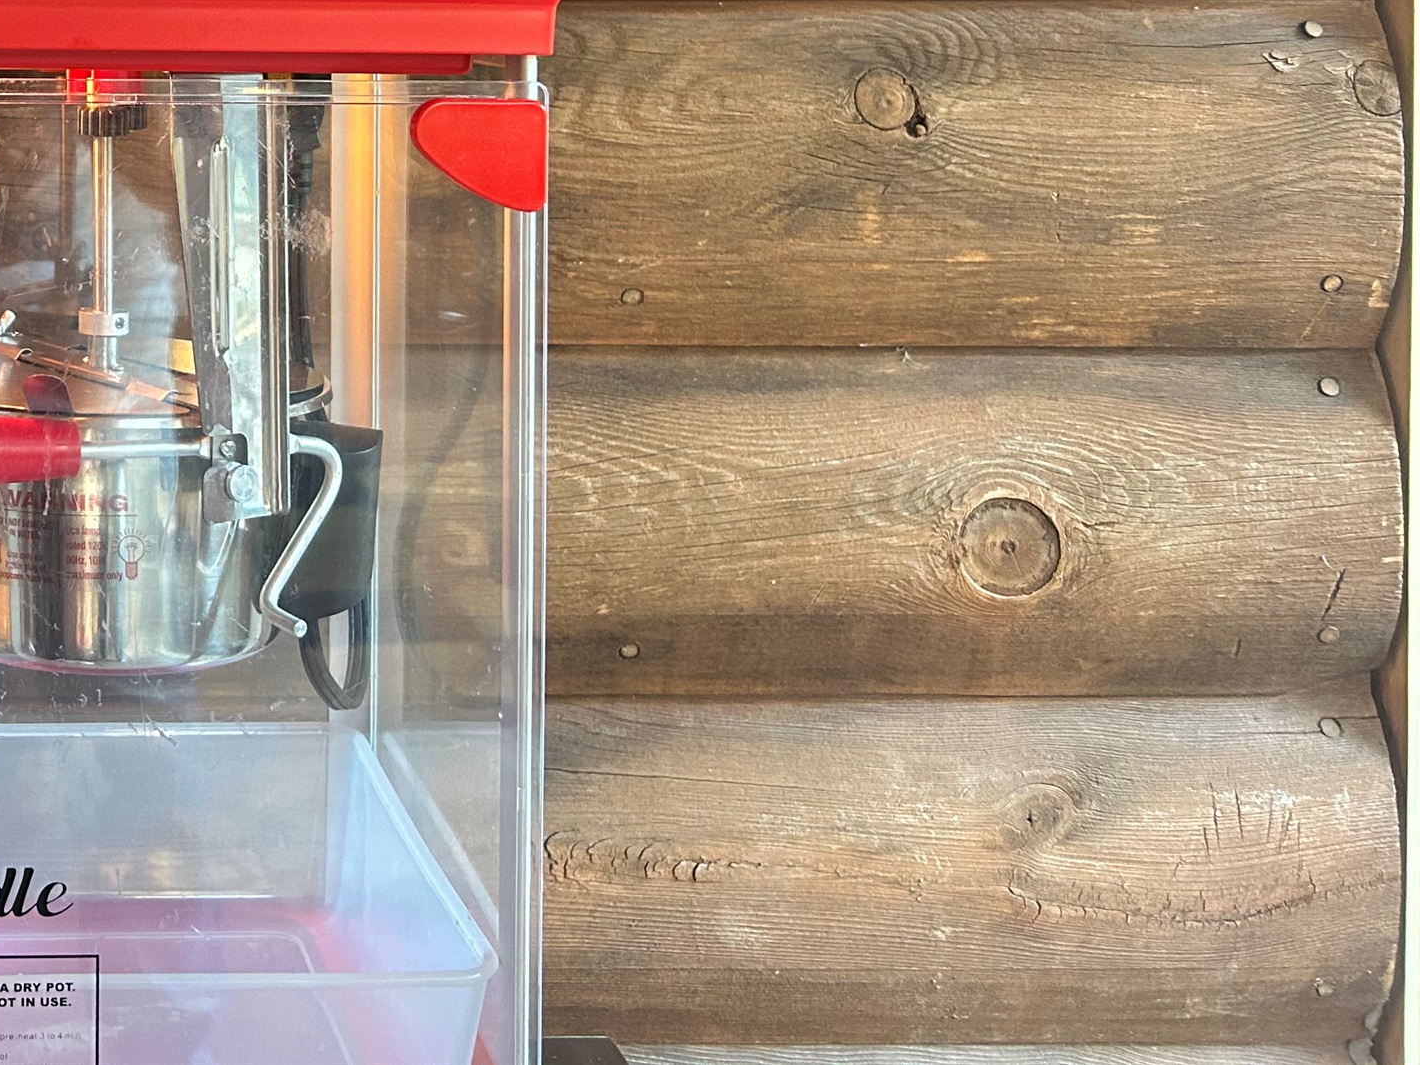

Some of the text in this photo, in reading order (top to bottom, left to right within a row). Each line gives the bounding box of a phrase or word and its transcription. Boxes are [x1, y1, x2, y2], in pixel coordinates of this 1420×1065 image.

[65, 541, 86, 551] rated
[106, 570, 124, 582] only
[0, 983, 9, 992] A
[13, 982, 41, 992] DRY
[46, 982, 76, 992] POT.
[21, 997, 35, 1007] IN
[40, 997, 72, 1007] USE.
[47, 1032, 55, 1040] to
[57, 1032, 63, 1040] 4
